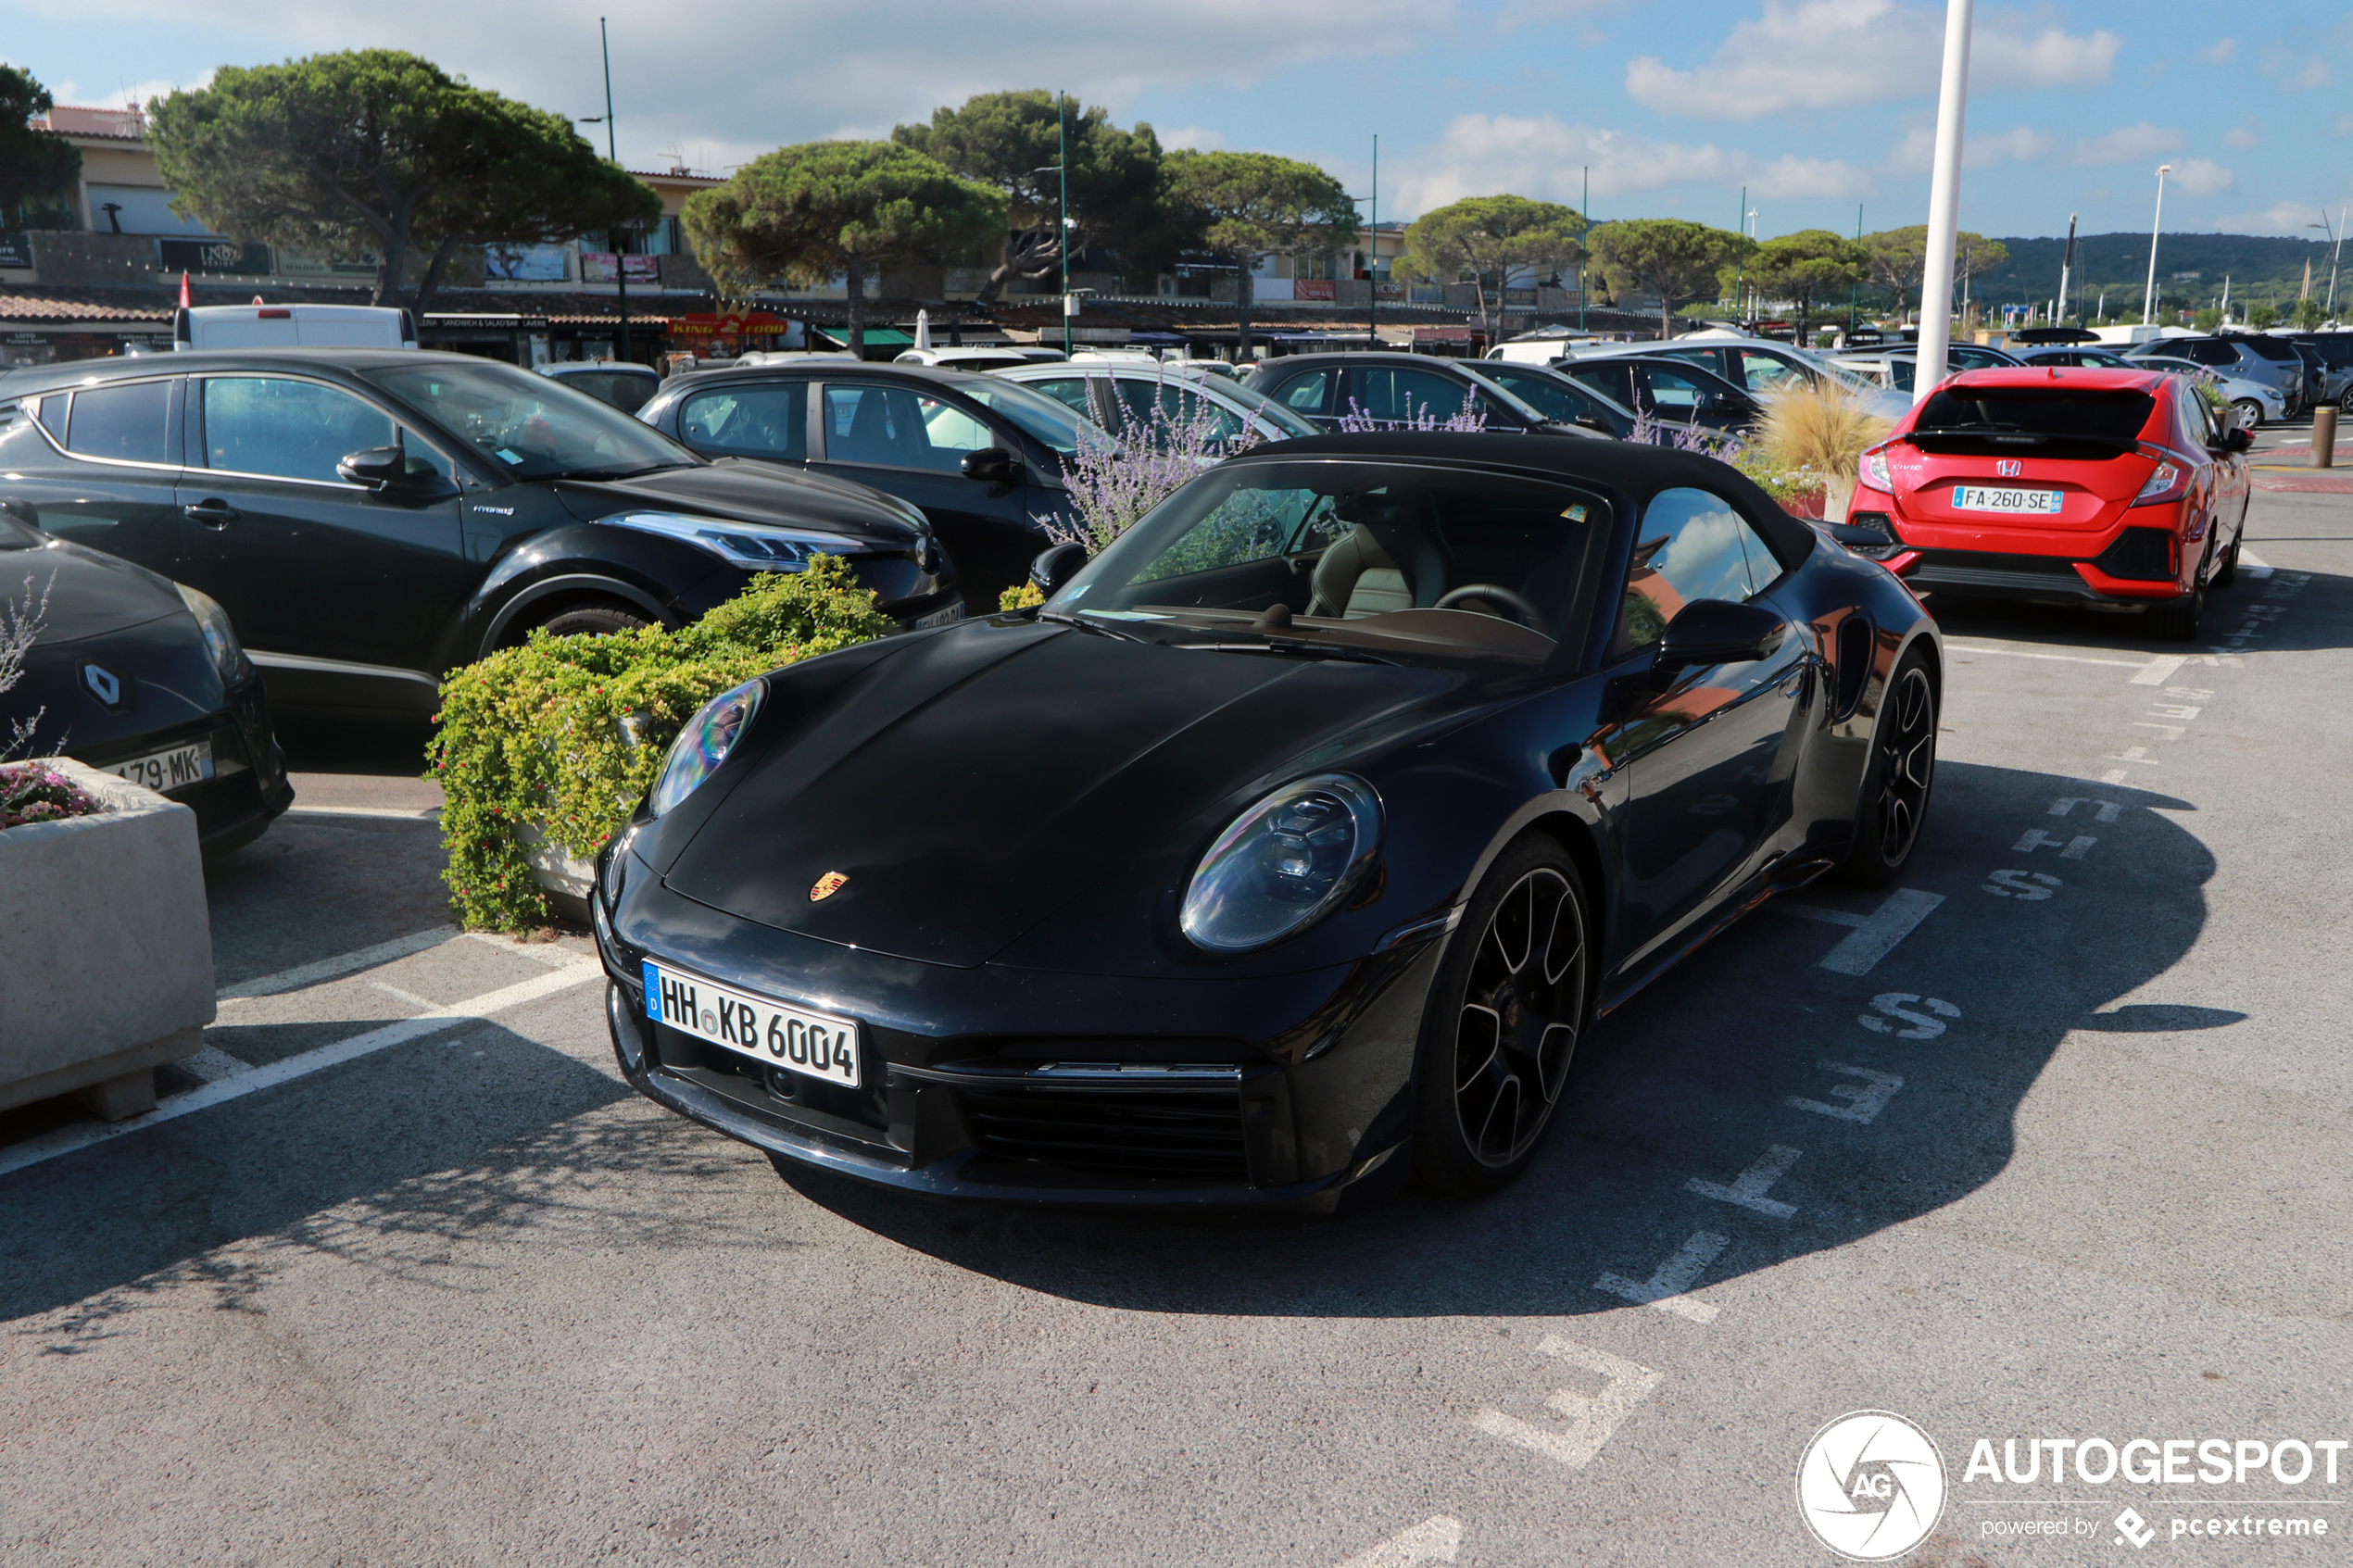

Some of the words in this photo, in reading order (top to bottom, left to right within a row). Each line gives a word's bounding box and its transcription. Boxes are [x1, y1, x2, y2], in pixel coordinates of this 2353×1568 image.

[1375, 283, 1403, 294] VICTOR
[442, 319, 478, 327] SANDWICH
[673, 323, 713, 333] KING
[745, 324, 785, 333] FOOD
[1965, 490, 2050, 508] FA-260-SE
[650, 997, 658, 1010] D
[661, 976, 698, 1029] HH
[718, 997, 758, 1048] KB
[768, 1014, 852, 1077] 6004
